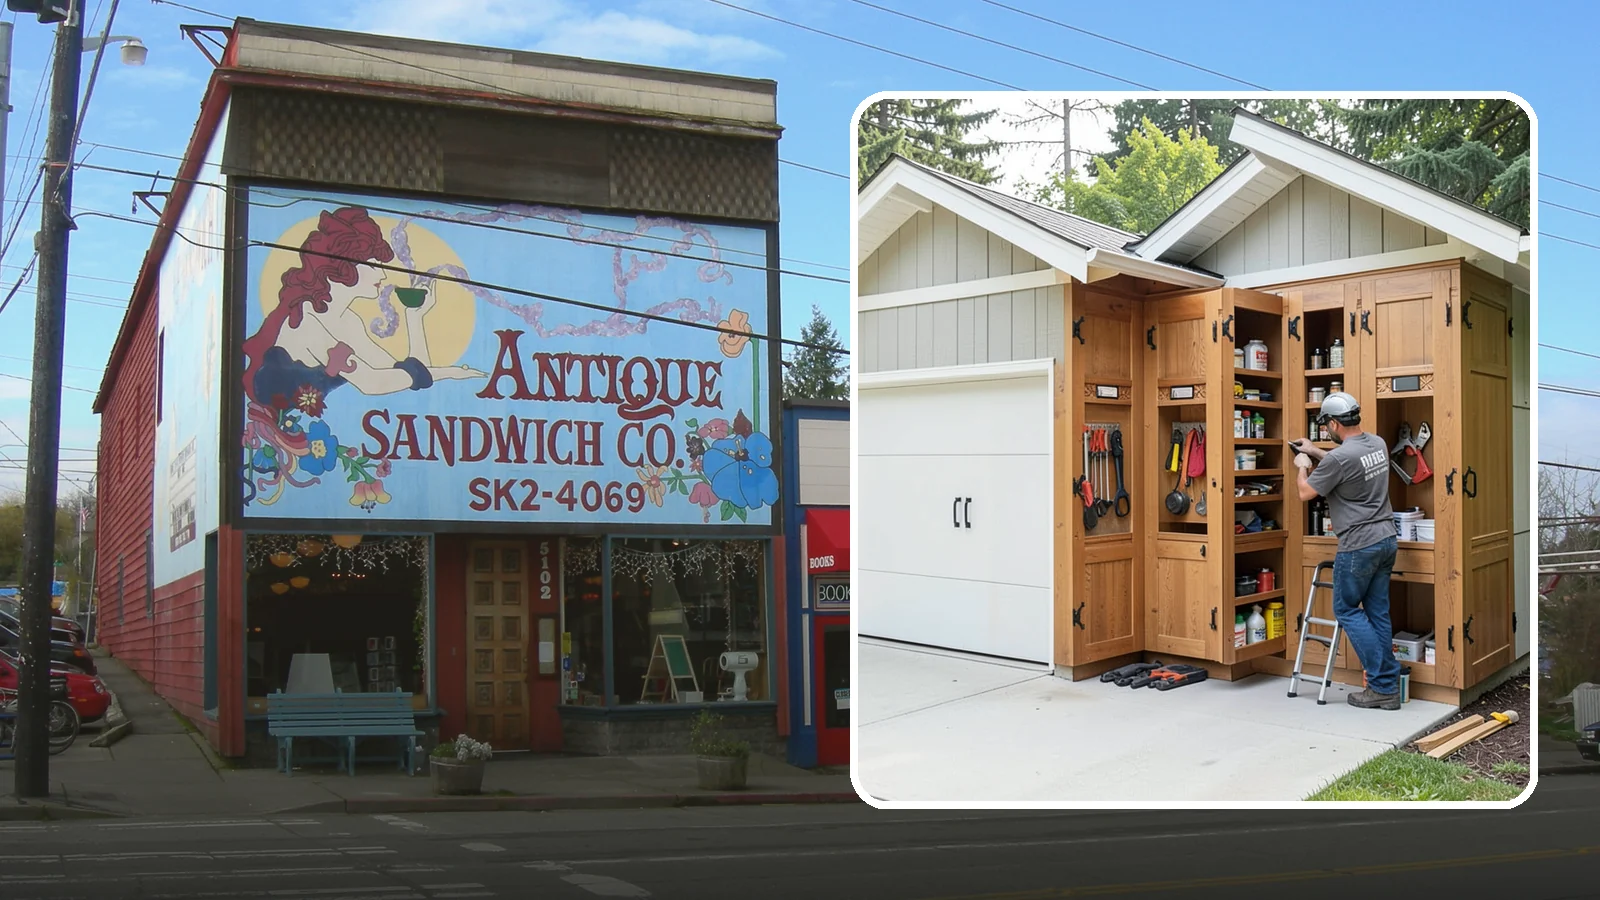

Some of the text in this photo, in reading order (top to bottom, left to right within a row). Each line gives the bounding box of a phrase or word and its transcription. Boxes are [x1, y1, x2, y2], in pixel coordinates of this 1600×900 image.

[476, 329, 724, 419] ANTIQUE
[361, 409, 686, 470] SANDWICH CO.
[469, 477, 646, 512] SK2-4069
[540, 541, 551, 600] 5102
[809, 555, 835, 569] BOOKS
